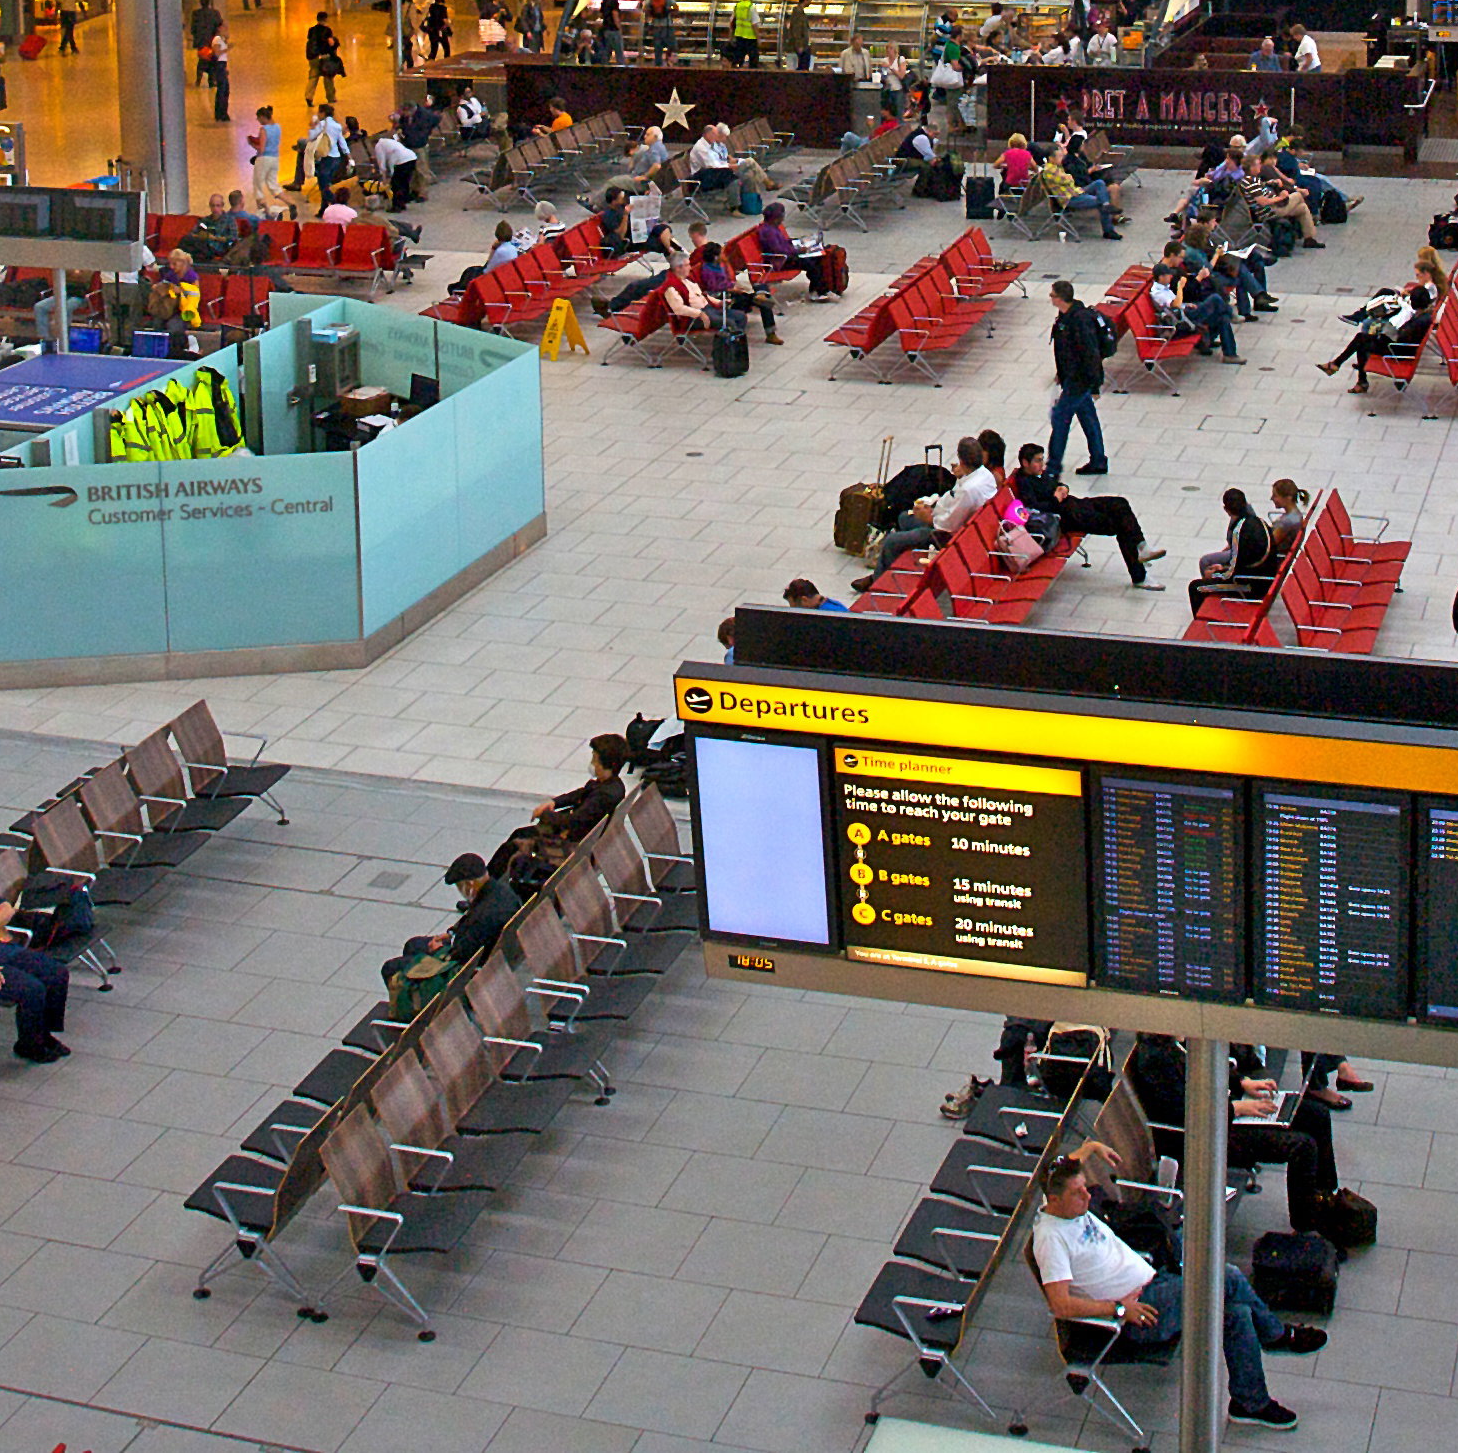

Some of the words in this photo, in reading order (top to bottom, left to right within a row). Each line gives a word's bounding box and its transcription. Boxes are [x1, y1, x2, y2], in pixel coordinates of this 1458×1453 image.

[1081, 88, 1126, 119] PRET
[1136, 90, 1150, 120] A
[1159, 91, 1242, 122] MANGER
[87, 482, 170, 503] BRITISH
[174, 477, 263, 498] AIRWAYS
[88, 507, 173, 525] Customer
[180, 501, 252, 520] Services
[270, 496, 334, 515] Central
[719, 691, 870, 724] Departures
[862, 756, 895, 770] Time
[899, 760, 953, 775] planner
[844, 783, 889, 800] Please
[892, 789, 932, 804] allow
[934, 793, 960, 808] the
[962, 796, 1034, 817] following
[845, 798, 878, 812] time
[880, 801, 897, 814] to
[899, 805, 939, 819] reach
[941, 810, 976, 823] your
[978, 811, 1012, 826] gate
[877, 829, 888, 841] A
[891, 831, 932, 847] gates
[951, 837, 969, 850] 10
[971, 839, 1031, 857] minutes
[878, 869, 888, 881] B
[891, 872, 931, 887] gates
[953, 878, 971, 891] 15
[973, 880, 1032, 898] minutes
[953, 893, 984, 907] using
[985, 897, 1022, 910] transit
[881, 909, 891, 921] C
[894, 913, 933, 926] gates
[954, 917, 973, 931] 20
[975, 919, 1034, 937] minutes
[955, 933, 986, 947] using
[987, 937, 1024, 950] transit
[737, 955, 773, 969] 18:05
